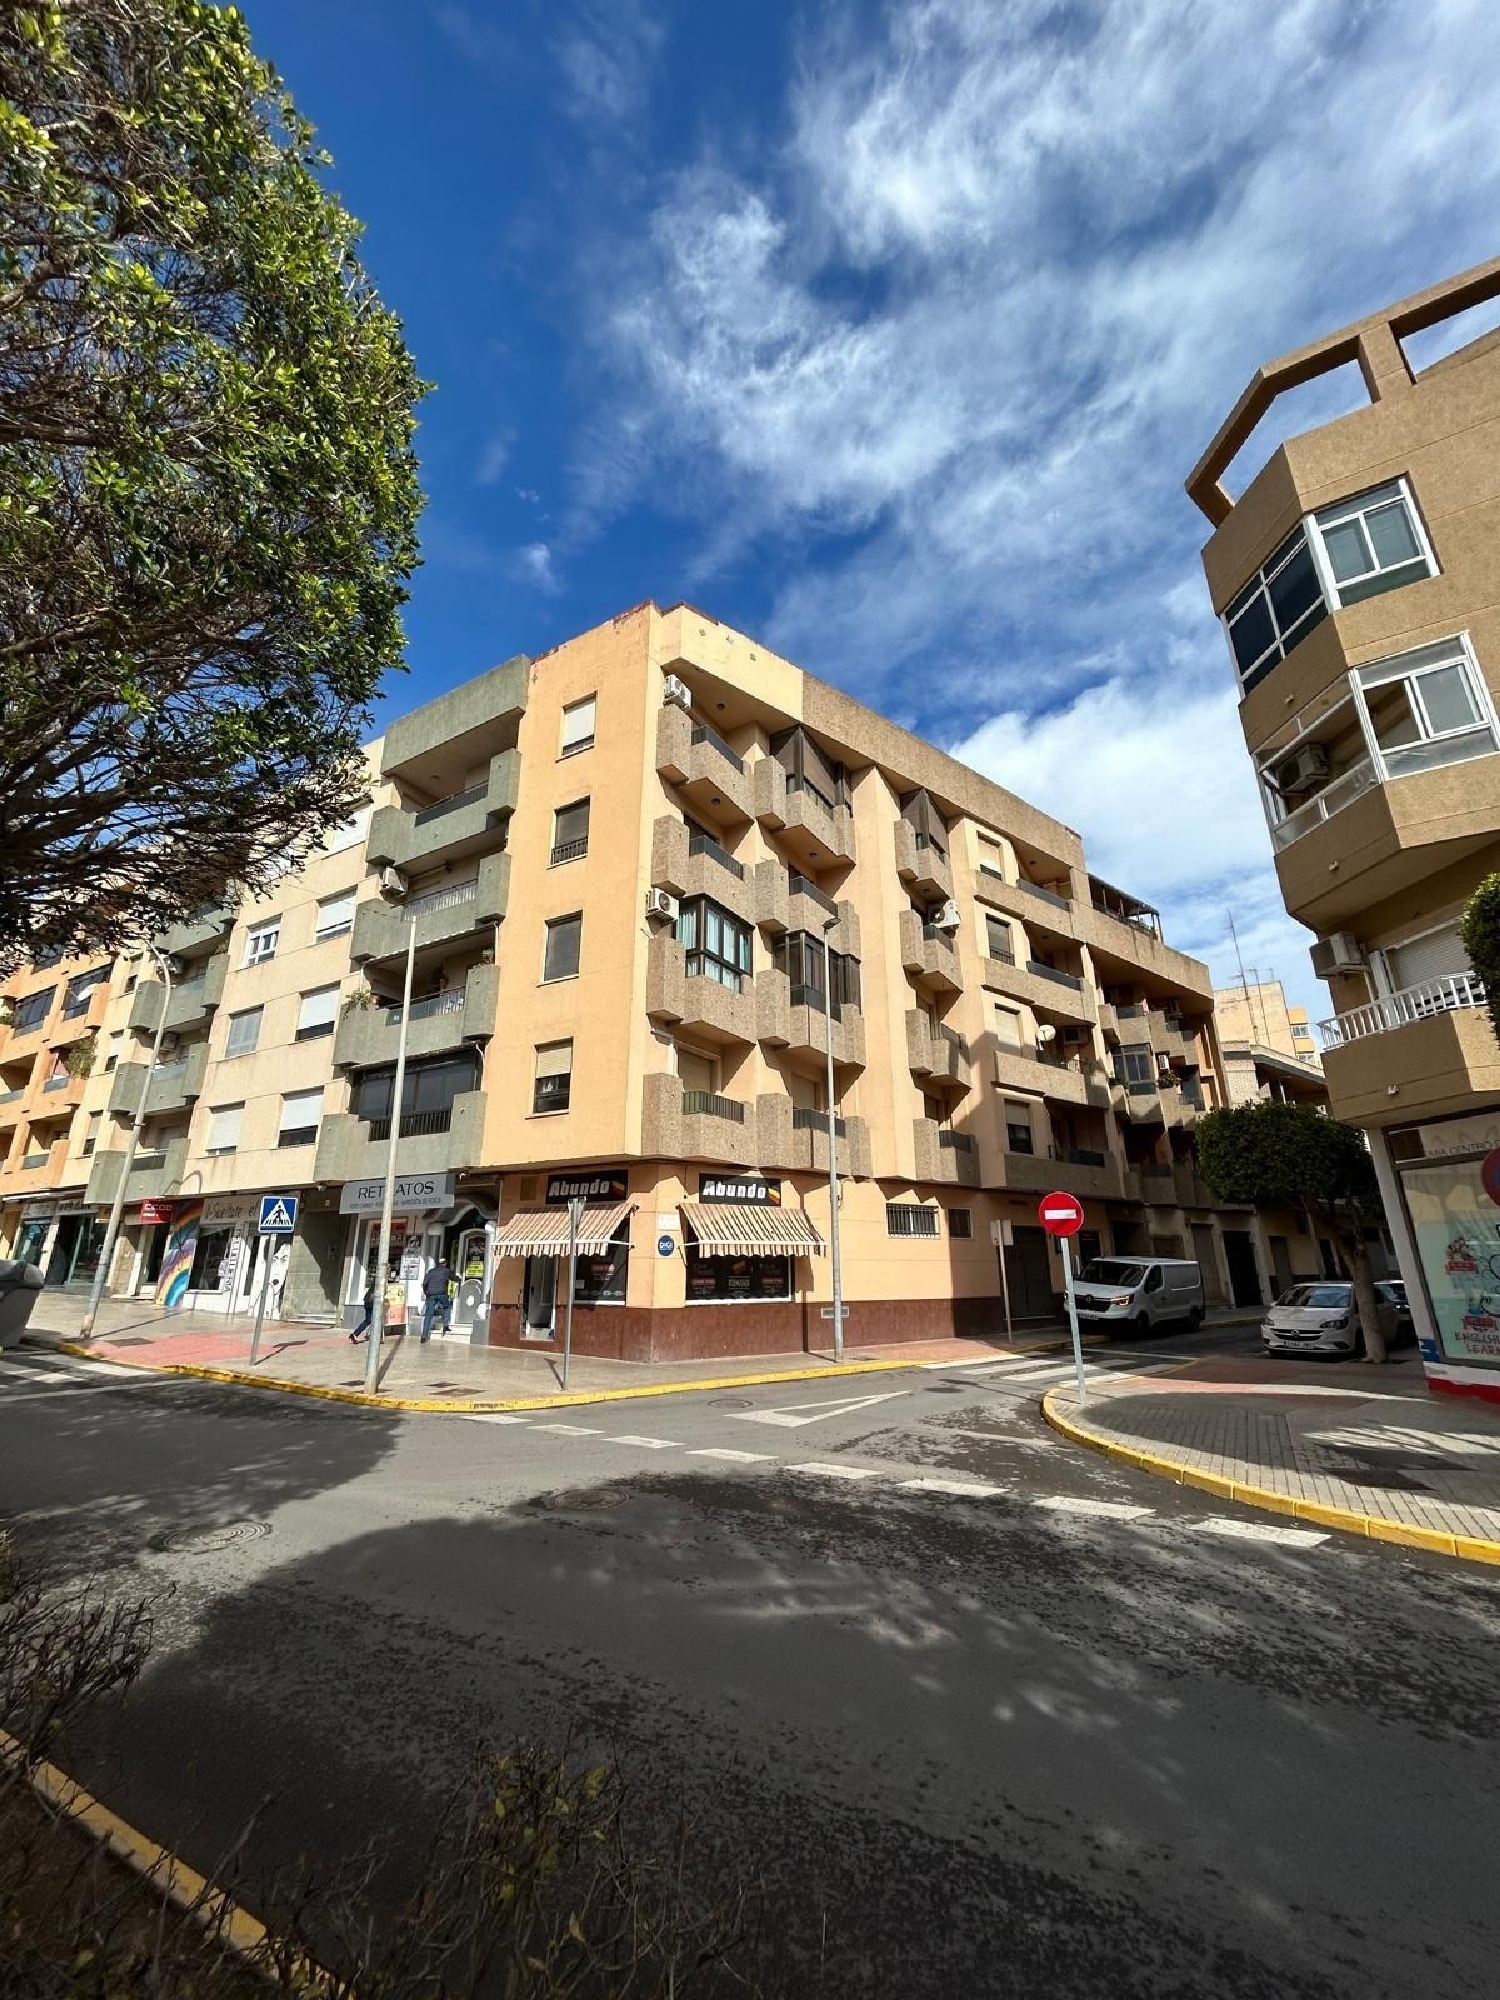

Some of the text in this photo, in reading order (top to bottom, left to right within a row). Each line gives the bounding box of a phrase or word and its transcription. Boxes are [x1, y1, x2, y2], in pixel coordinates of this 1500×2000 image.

[358, 1181, 434, 1199] RETATOS
[549, 1179, 610, 1196] Abundo
[703, 1180, 766, 1198] Abundo
